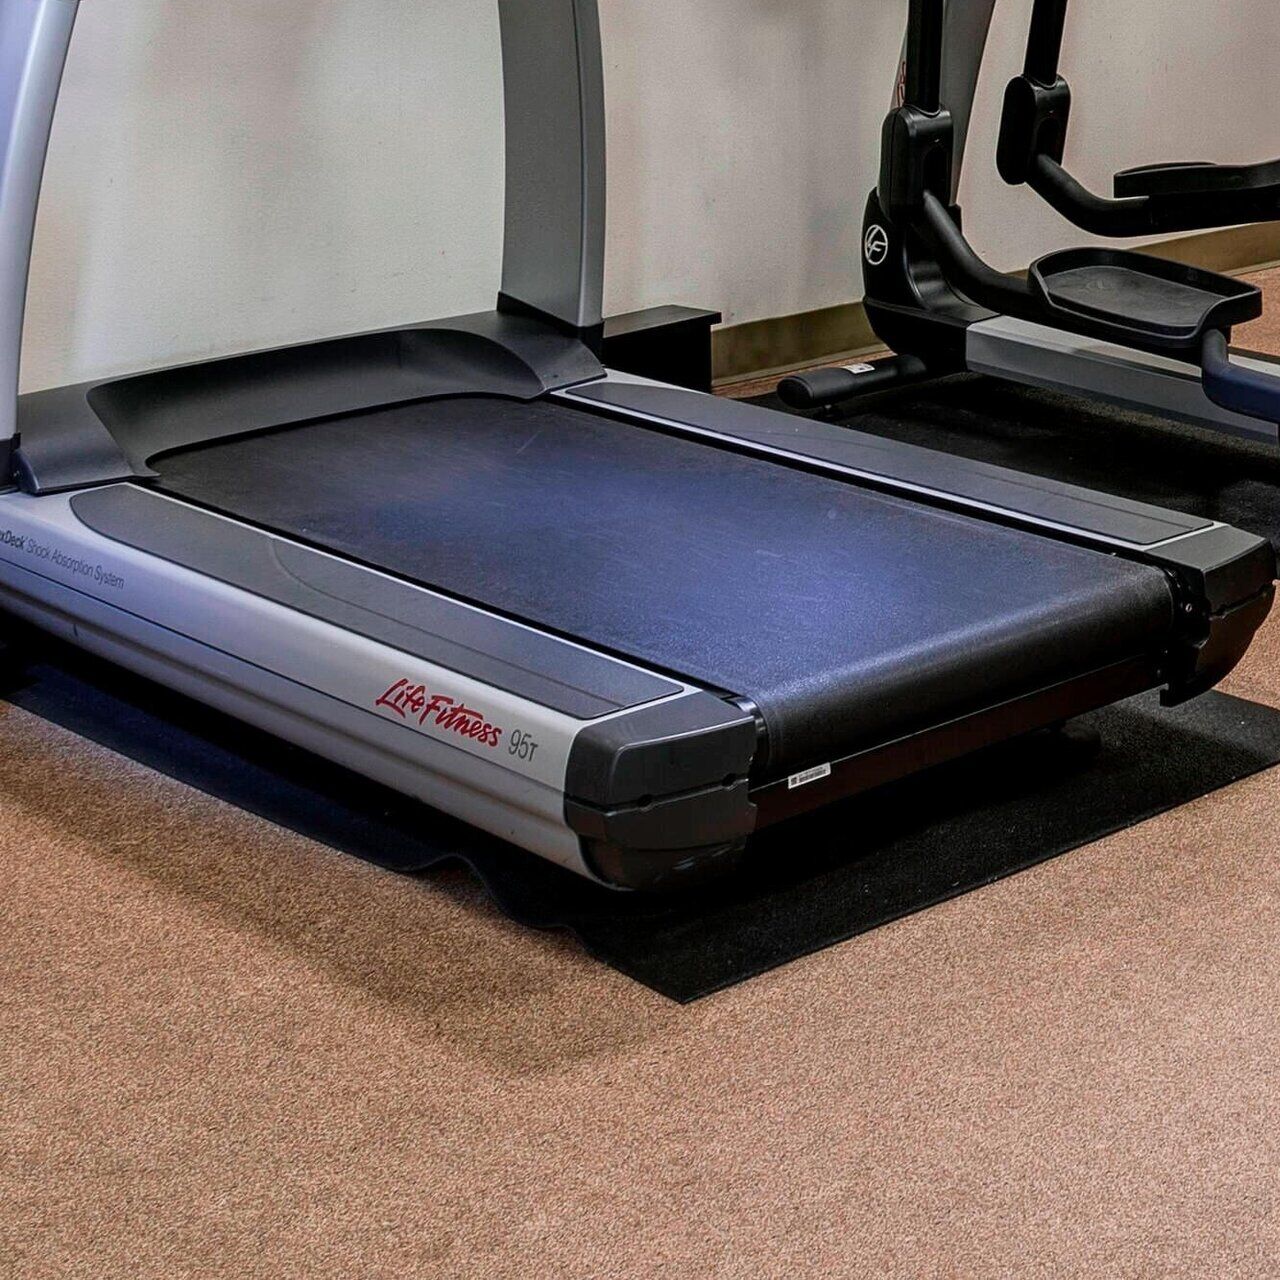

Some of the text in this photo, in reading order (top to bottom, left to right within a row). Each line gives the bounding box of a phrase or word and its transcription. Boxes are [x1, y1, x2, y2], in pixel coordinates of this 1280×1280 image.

[27, 538, 50, 559] Shock
[51, 549, 94, 576] Absorption
[94, 564, 125, 589] System
